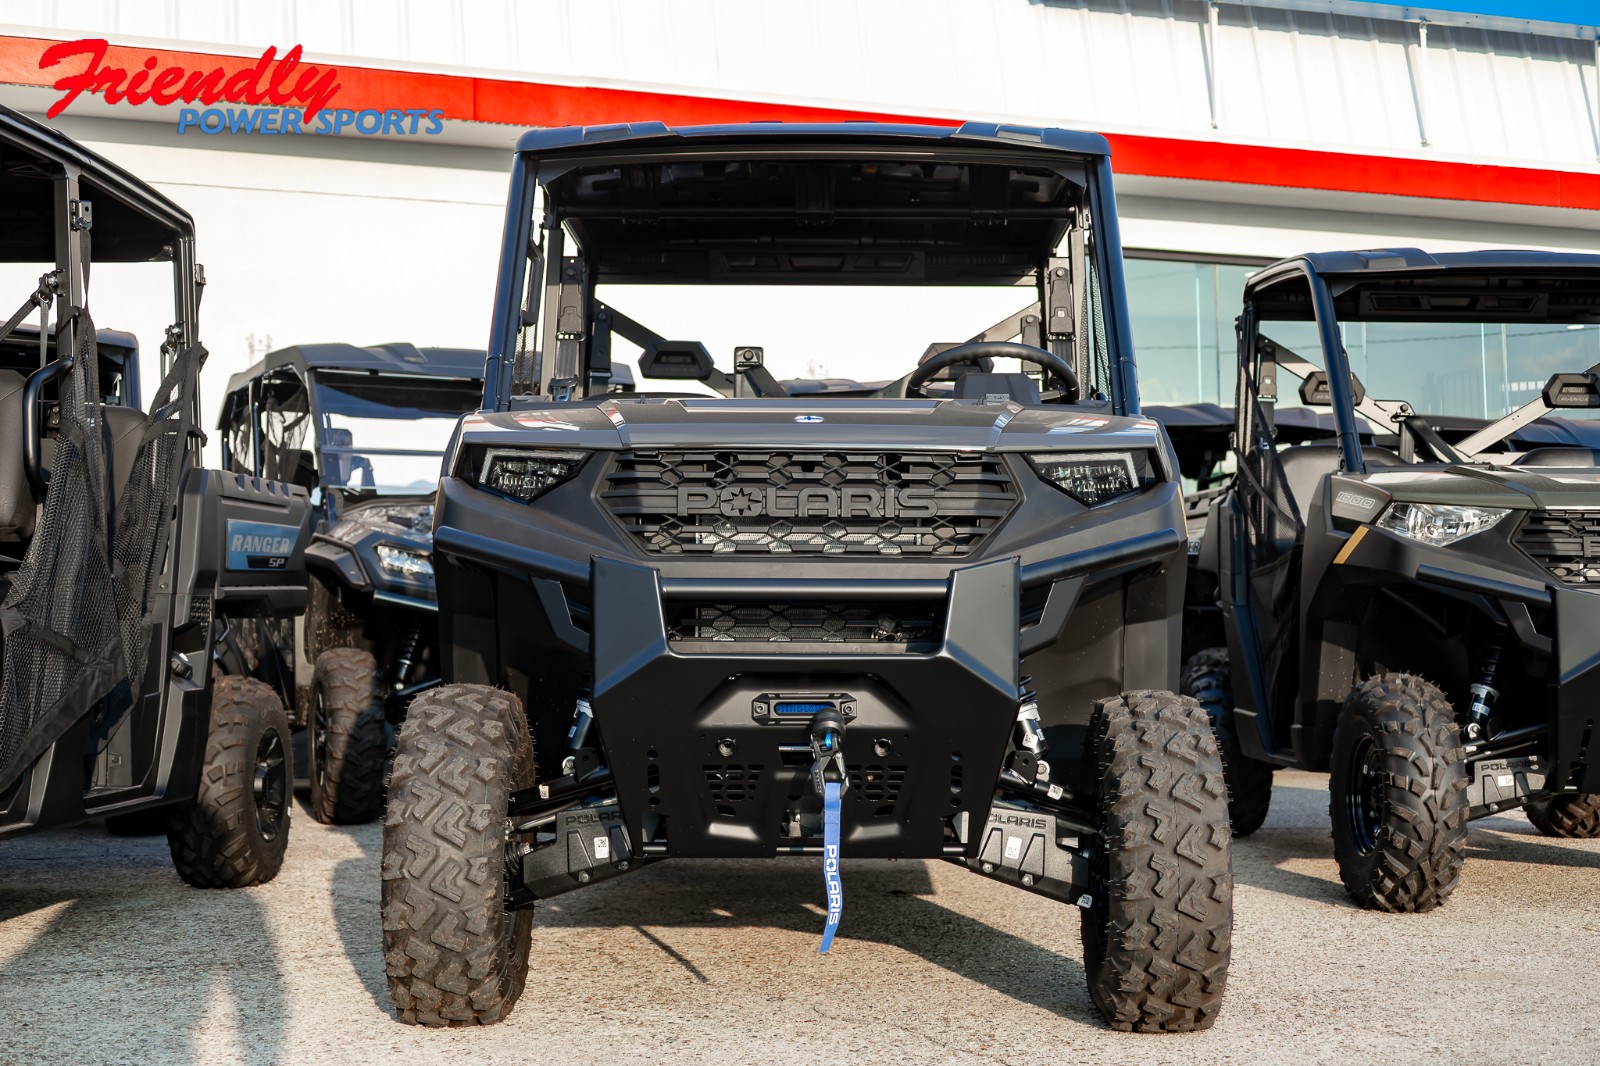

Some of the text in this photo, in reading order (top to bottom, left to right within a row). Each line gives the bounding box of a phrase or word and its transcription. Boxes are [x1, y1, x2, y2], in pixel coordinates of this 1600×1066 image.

[677, 487, 938, 518] POLARIS
[231, 534, 290, 554] RANGER
[268, 558, 285, 567] SP
[566, 811, 621, 825] POLAR
[826, 845, 841, 925] POLARIS
